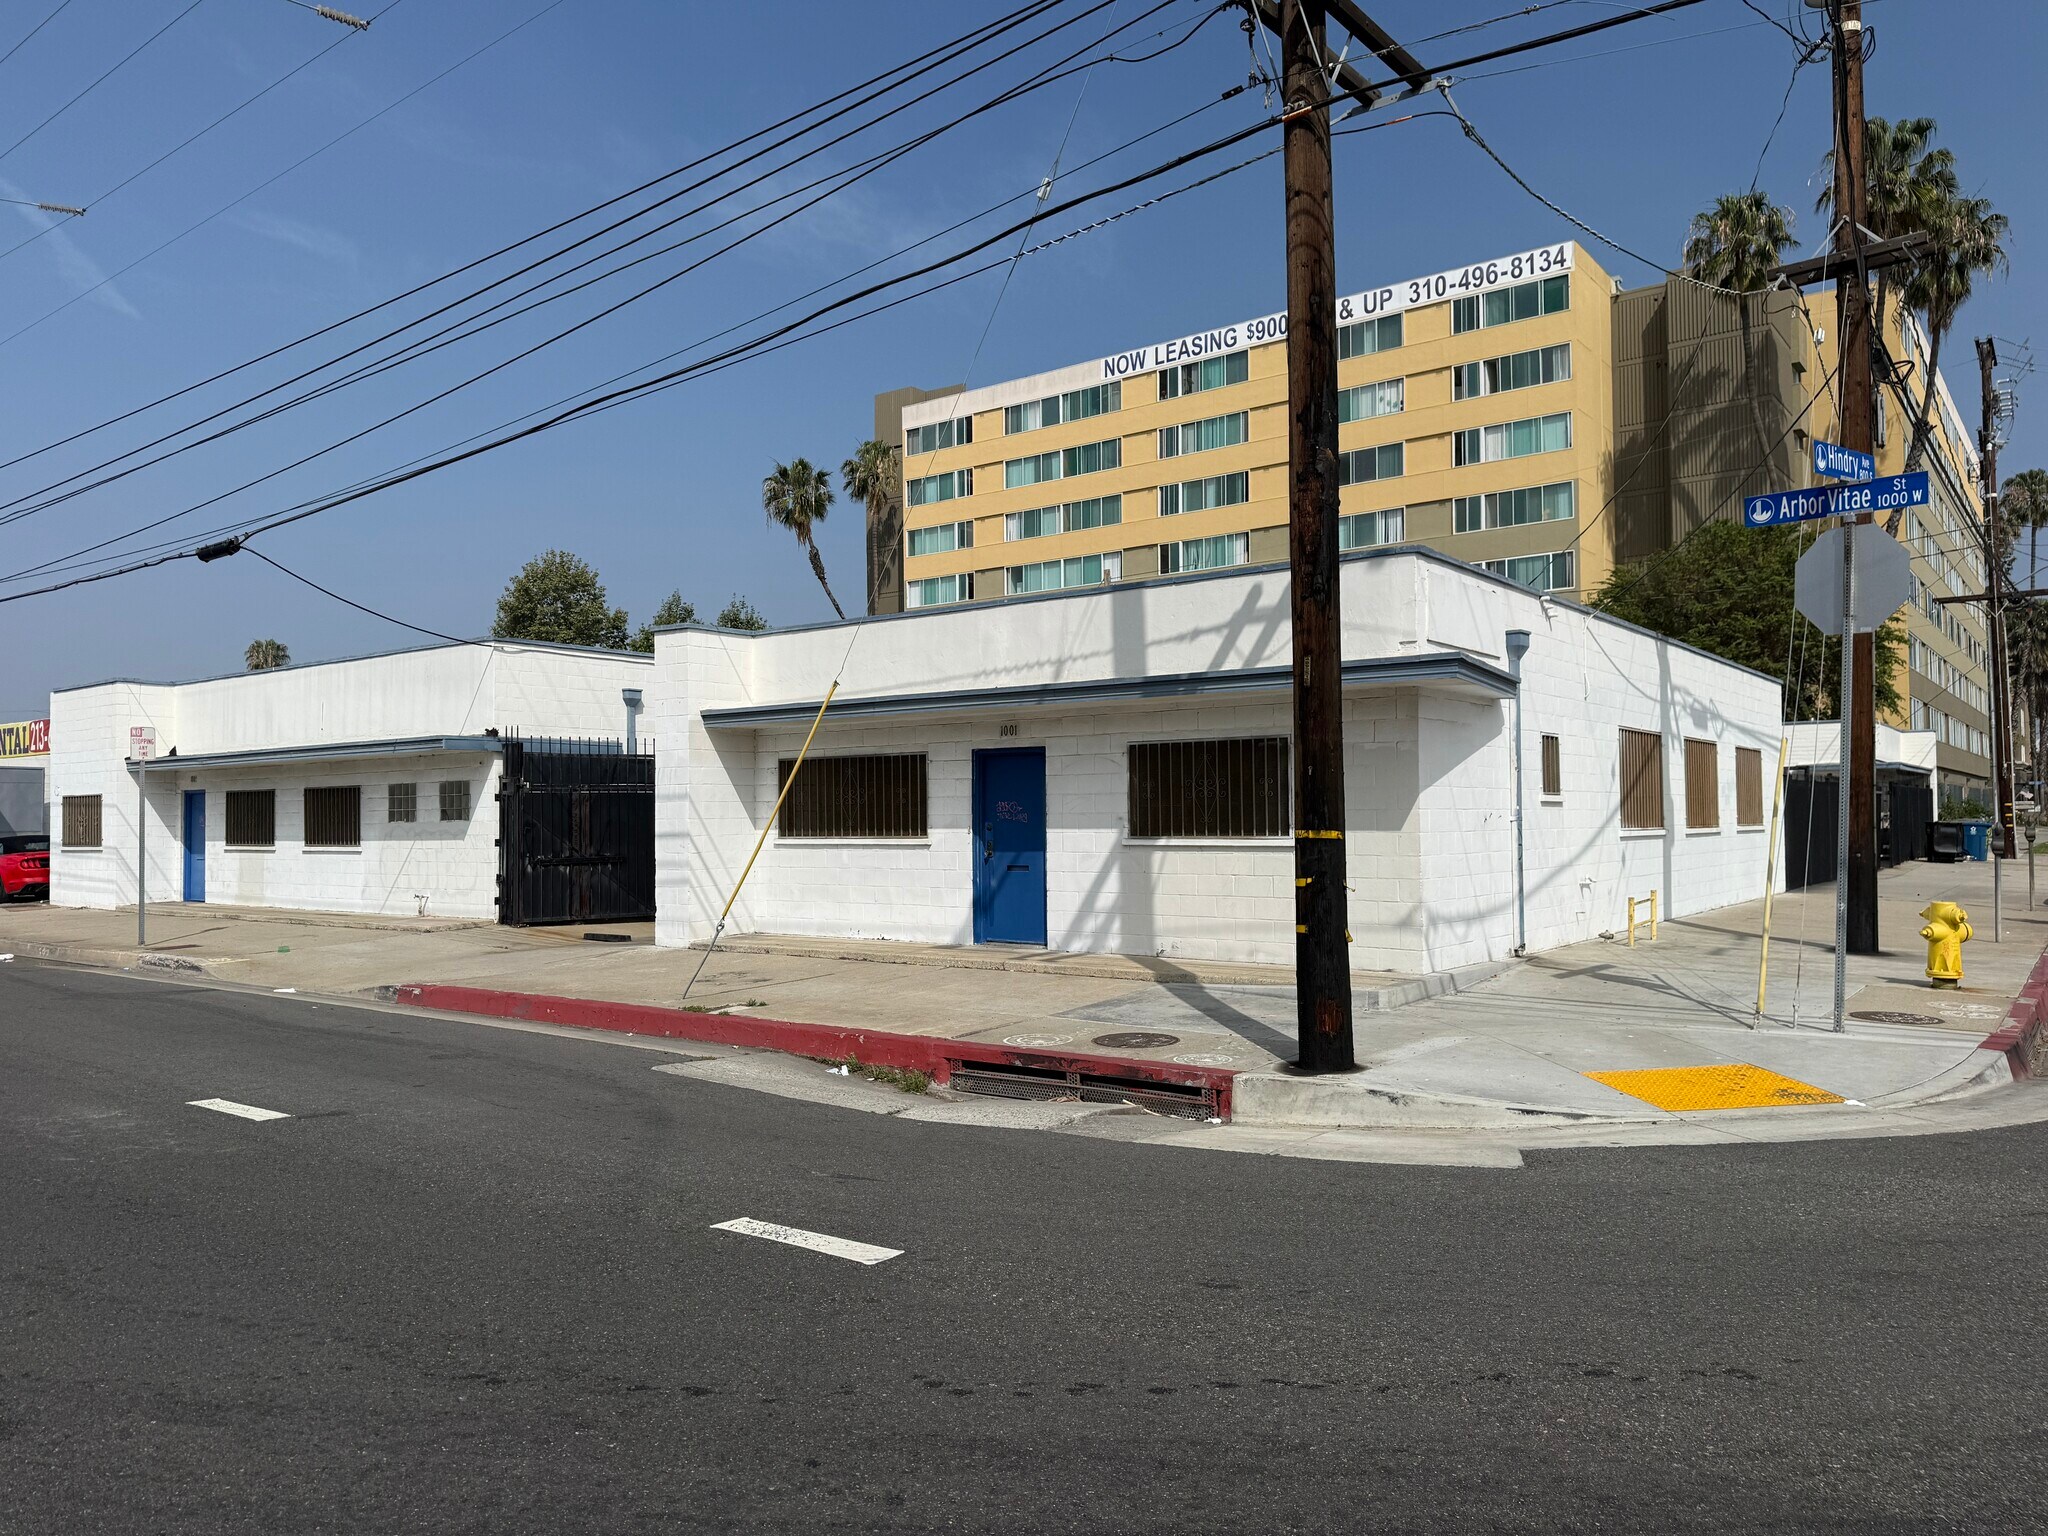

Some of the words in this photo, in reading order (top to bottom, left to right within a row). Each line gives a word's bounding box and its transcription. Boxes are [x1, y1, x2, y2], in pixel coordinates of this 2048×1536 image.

[1104, 349, 1147, 378] NOW
[1154, 328, 1238, 366] LEASING
[1246, 314, 1288, 342] $900
[1339, 298, 1354, 320] &
[1363, 288, 1393, 314] UP
[1408, 245, 1567, 303] 310-496-8134
[1828, 444, 1859, 480] Hindry
[1861, 455, 1870, 469] Ave
[1893, 478, 1907, 491] St
[1779, 494, 1826, 519] Arbor
[1827, 488, 1871, 512] Vitae
[1877, 491, 1908, 507] 1000
[1912, 489, 1923, 502] W
[30, 720, 50, 750] 213-
[131, 728, 141, 737] NO
[1000, 724, 1018, 736] 1001
[132, 737, 155, 745] STOPPING
